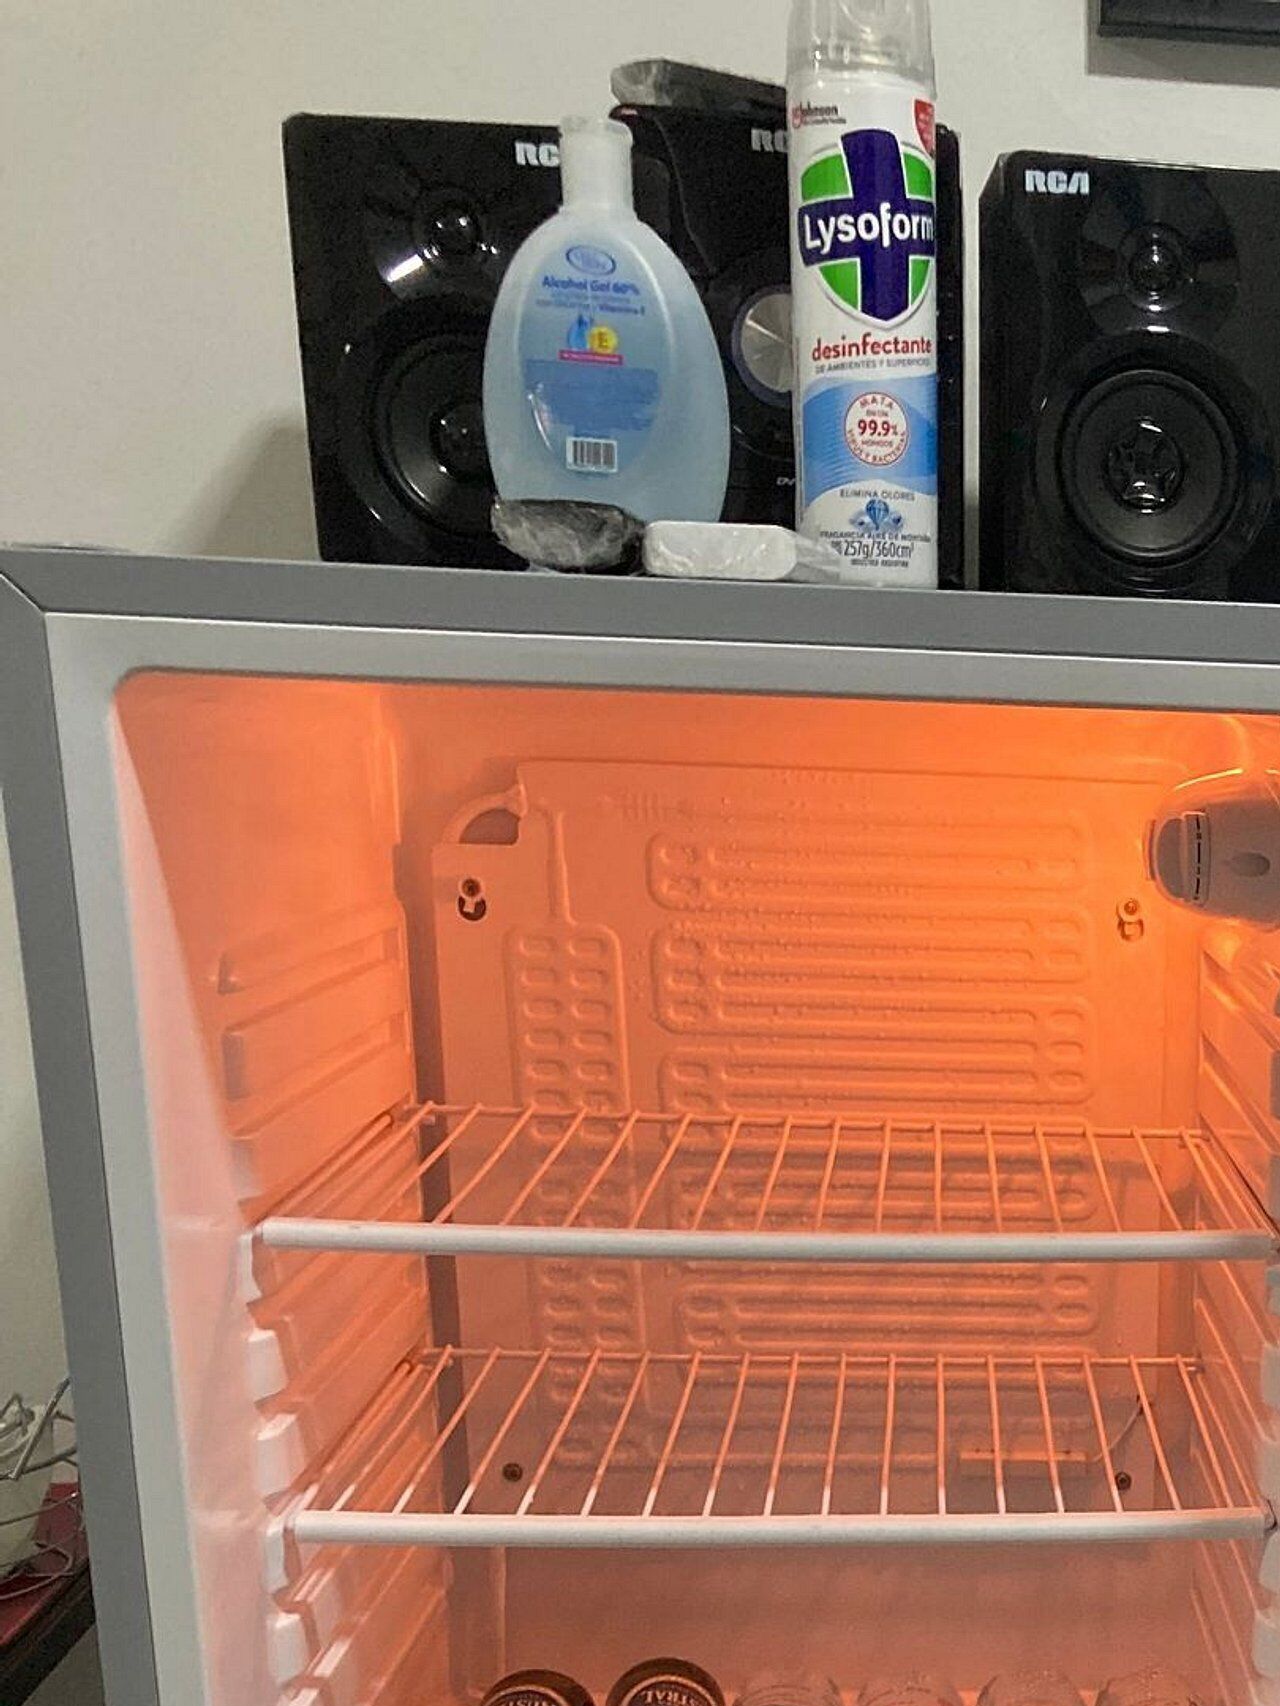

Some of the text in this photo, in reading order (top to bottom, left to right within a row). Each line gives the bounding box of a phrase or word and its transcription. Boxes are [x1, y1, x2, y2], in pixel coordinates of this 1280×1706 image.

[751, 128, 788, 151] RC
[514, 142, 561, 167] RC
[1025, 170, 1091, 195] RCA
[804, 201, 935, 254] Lysoform
[812, 332, 932, 361] desinfectante
[840, 488, 878, 499] ELIMINA
